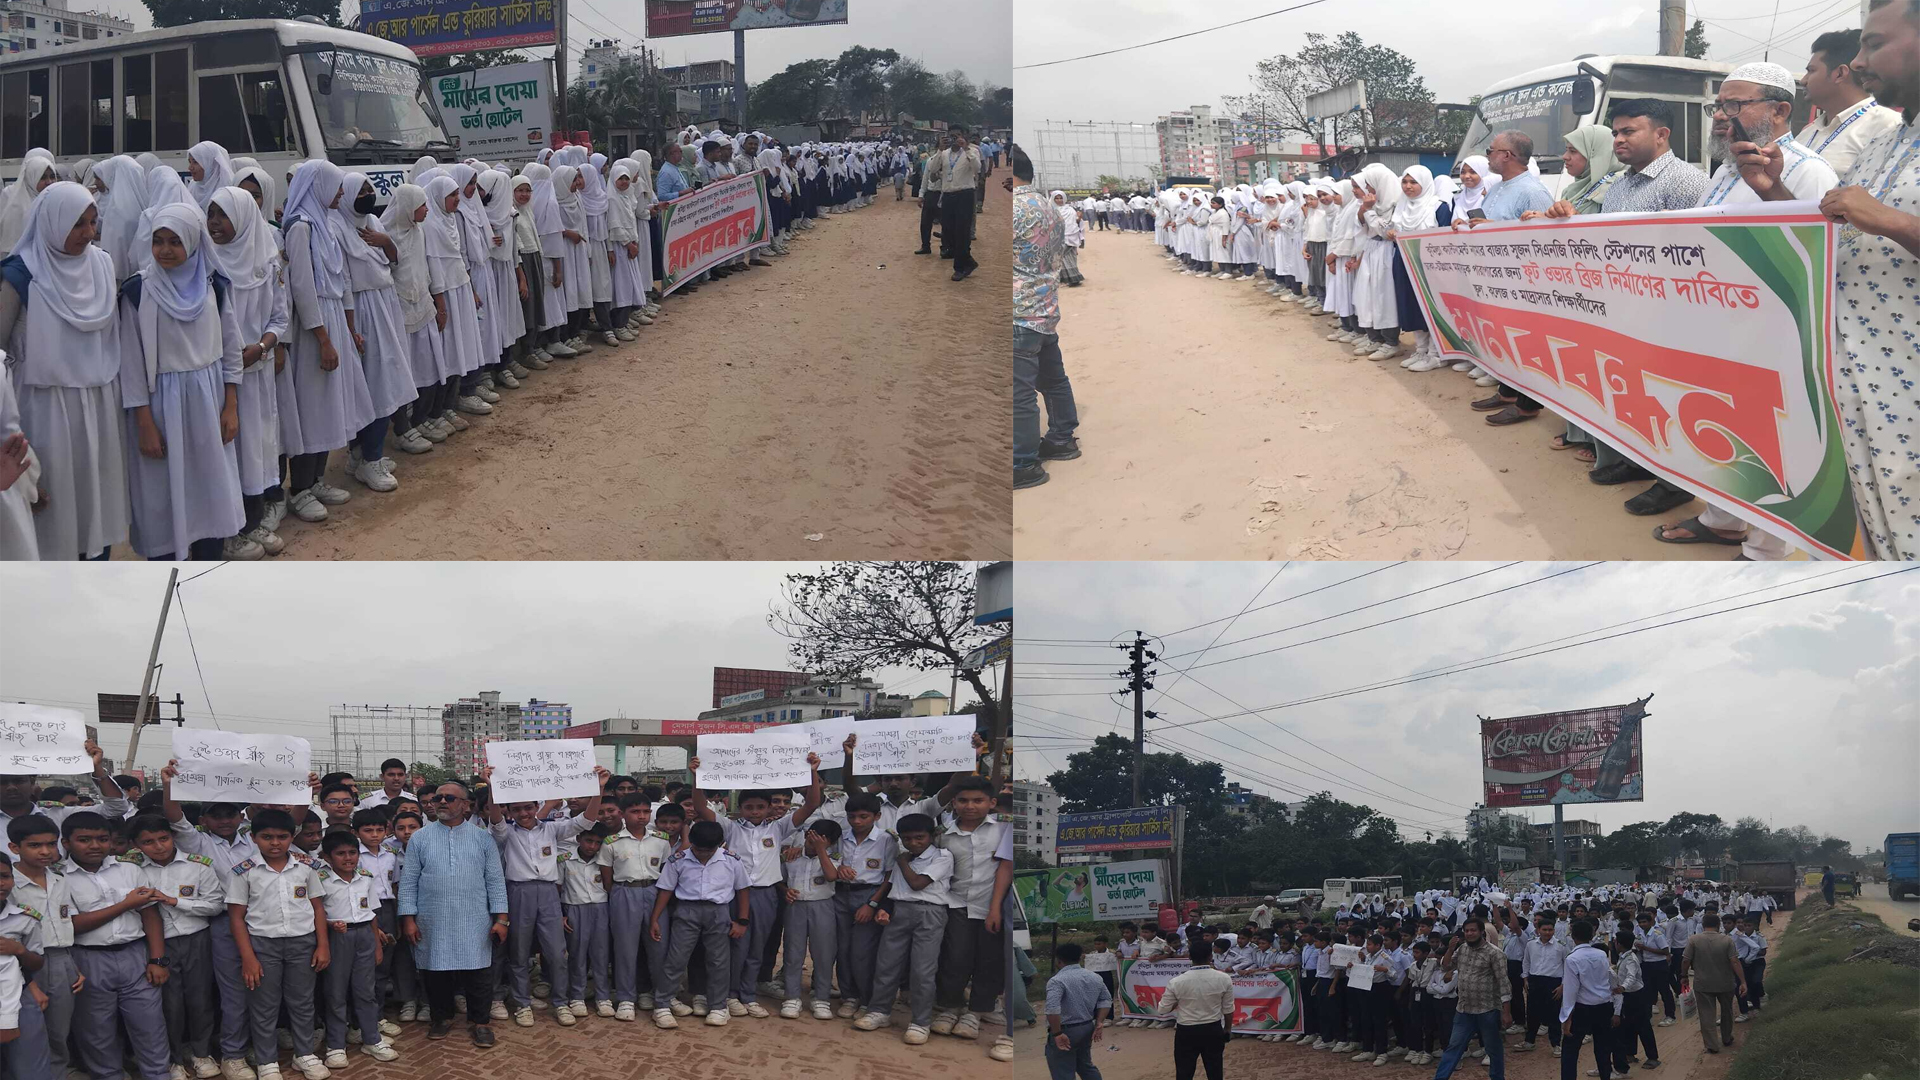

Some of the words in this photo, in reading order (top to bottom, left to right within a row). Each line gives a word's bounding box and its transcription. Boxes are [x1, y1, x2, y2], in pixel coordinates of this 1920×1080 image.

[410, 8, 439, 37] পার্সেল
[462, 3, 498, 38] কুরিয়ার
[494, 80, 538, 106] দোয়া
[460, 108, 483, 129] ভর্তা
[486, 107, 523, 129] হোটেল
[366, 170, 405, 196] স্কুল
[1486, 243, 1509, 258] বাজার
[1509, 243, 1531, 262] সুজন
[1531, 239, 1567, 259] সিএনজি
[1567, 238, 1602, 262] ফিলিং
[1604, 238, 1656, 264] স্টেশনের
[1661, 243, 1706, 267] পাশে
[1504, 264, 1521, 280] জন্য
[1521, 260, 1540, 285] ফুট
[1543, 265, 1574, 287] ওভার
[1574, 261, 1603, 290] ব্রিজ
[1605, 263, 1667, 300] নির্মাণের
[1670, 271, 1760, 309] দাবিতে
[1487, 285, 1509, 299] কলেজ
[1510, 290, 1518, 301] ও
[1519, 288, 1552, 306] মাদ্রাসার
[1552, 291, 1607, 317] শিক্ষার্থীদের
[37, 732, 59, 745] চাই
[275, 746, 296, 768] চাই
[565, 759, 579, 770] চাই
[215, 772, 244, 787] পাবলিক
[1096, 873, 1126, 888] মায়ের
[1128, 870, 1154, 886] দোয়া
[1060, 899, 1091, 911] CLEMON
[1107, 889, 1121, 900] ভর্তা
[1122, 888, 1146, 900] হোটেল
